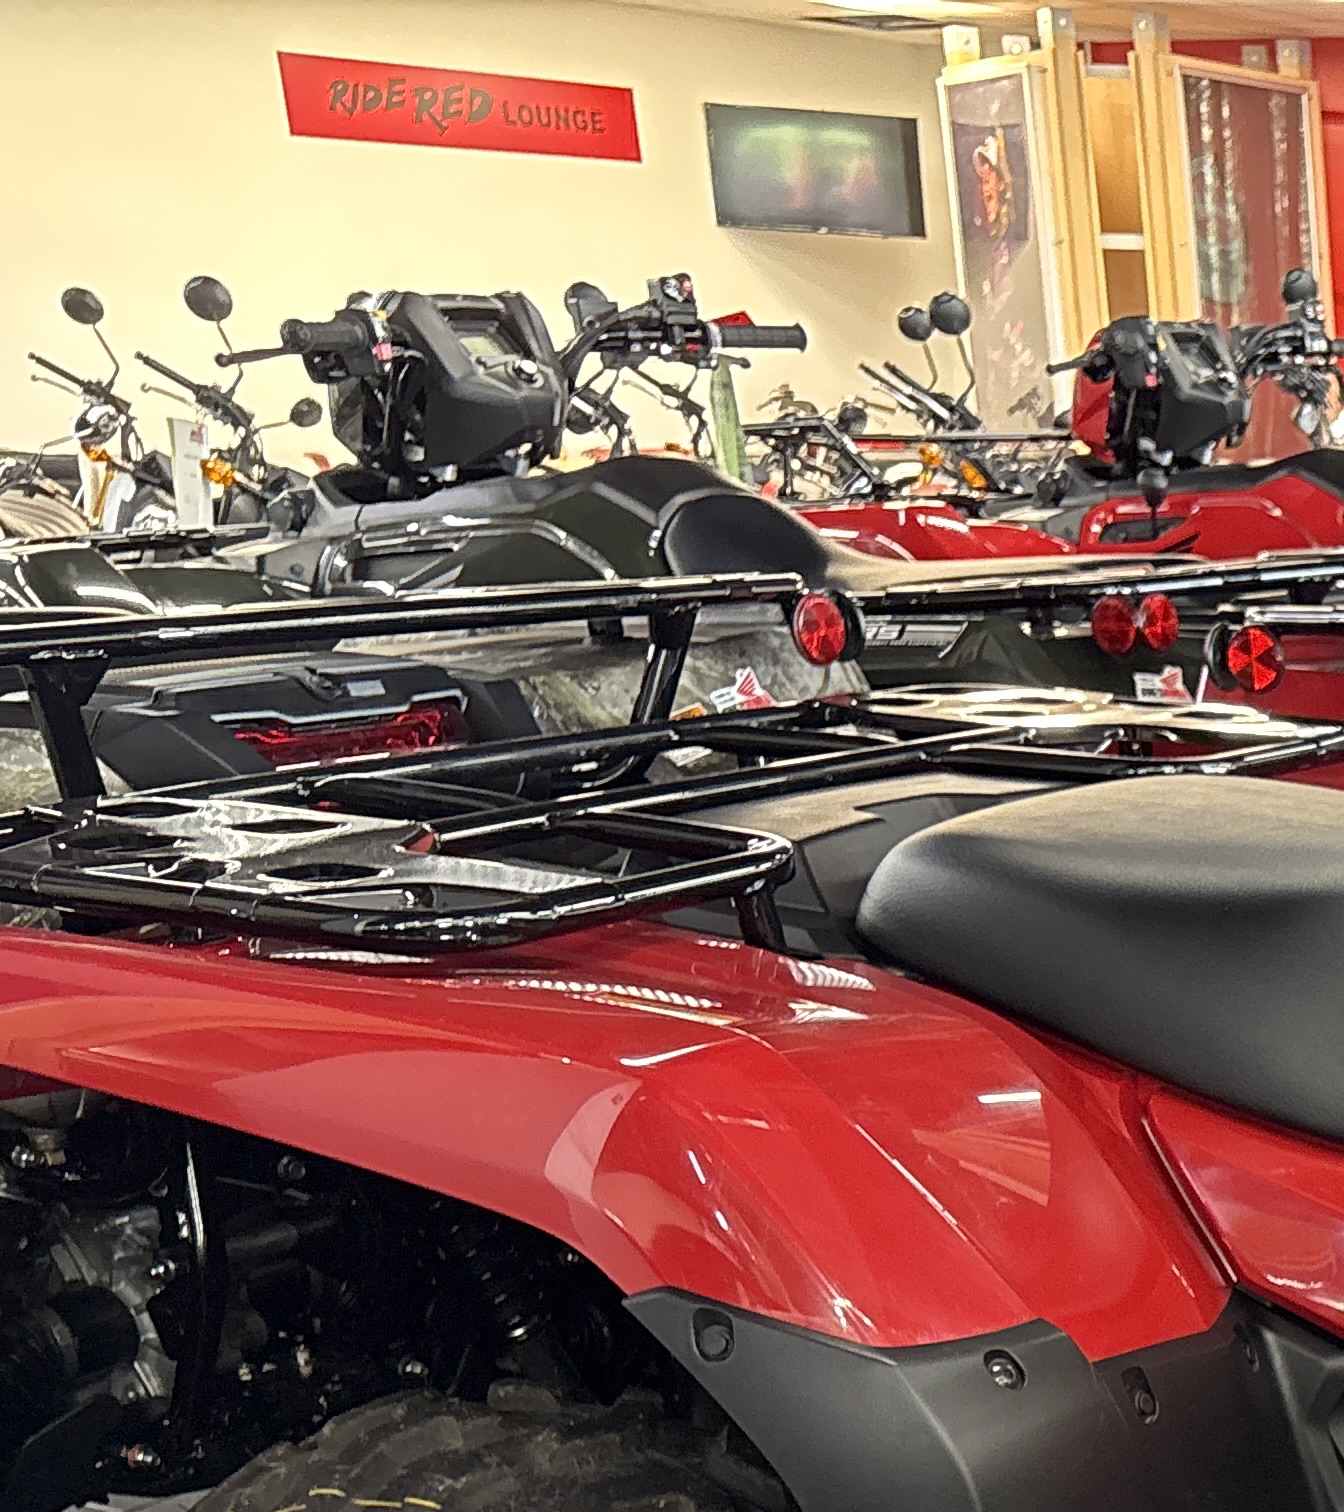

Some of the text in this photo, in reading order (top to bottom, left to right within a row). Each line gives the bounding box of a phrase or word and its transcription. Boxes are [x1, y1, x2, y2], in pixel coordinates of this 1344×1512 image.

[328, 78, 606, 137] RIDE RED LOUNGE
